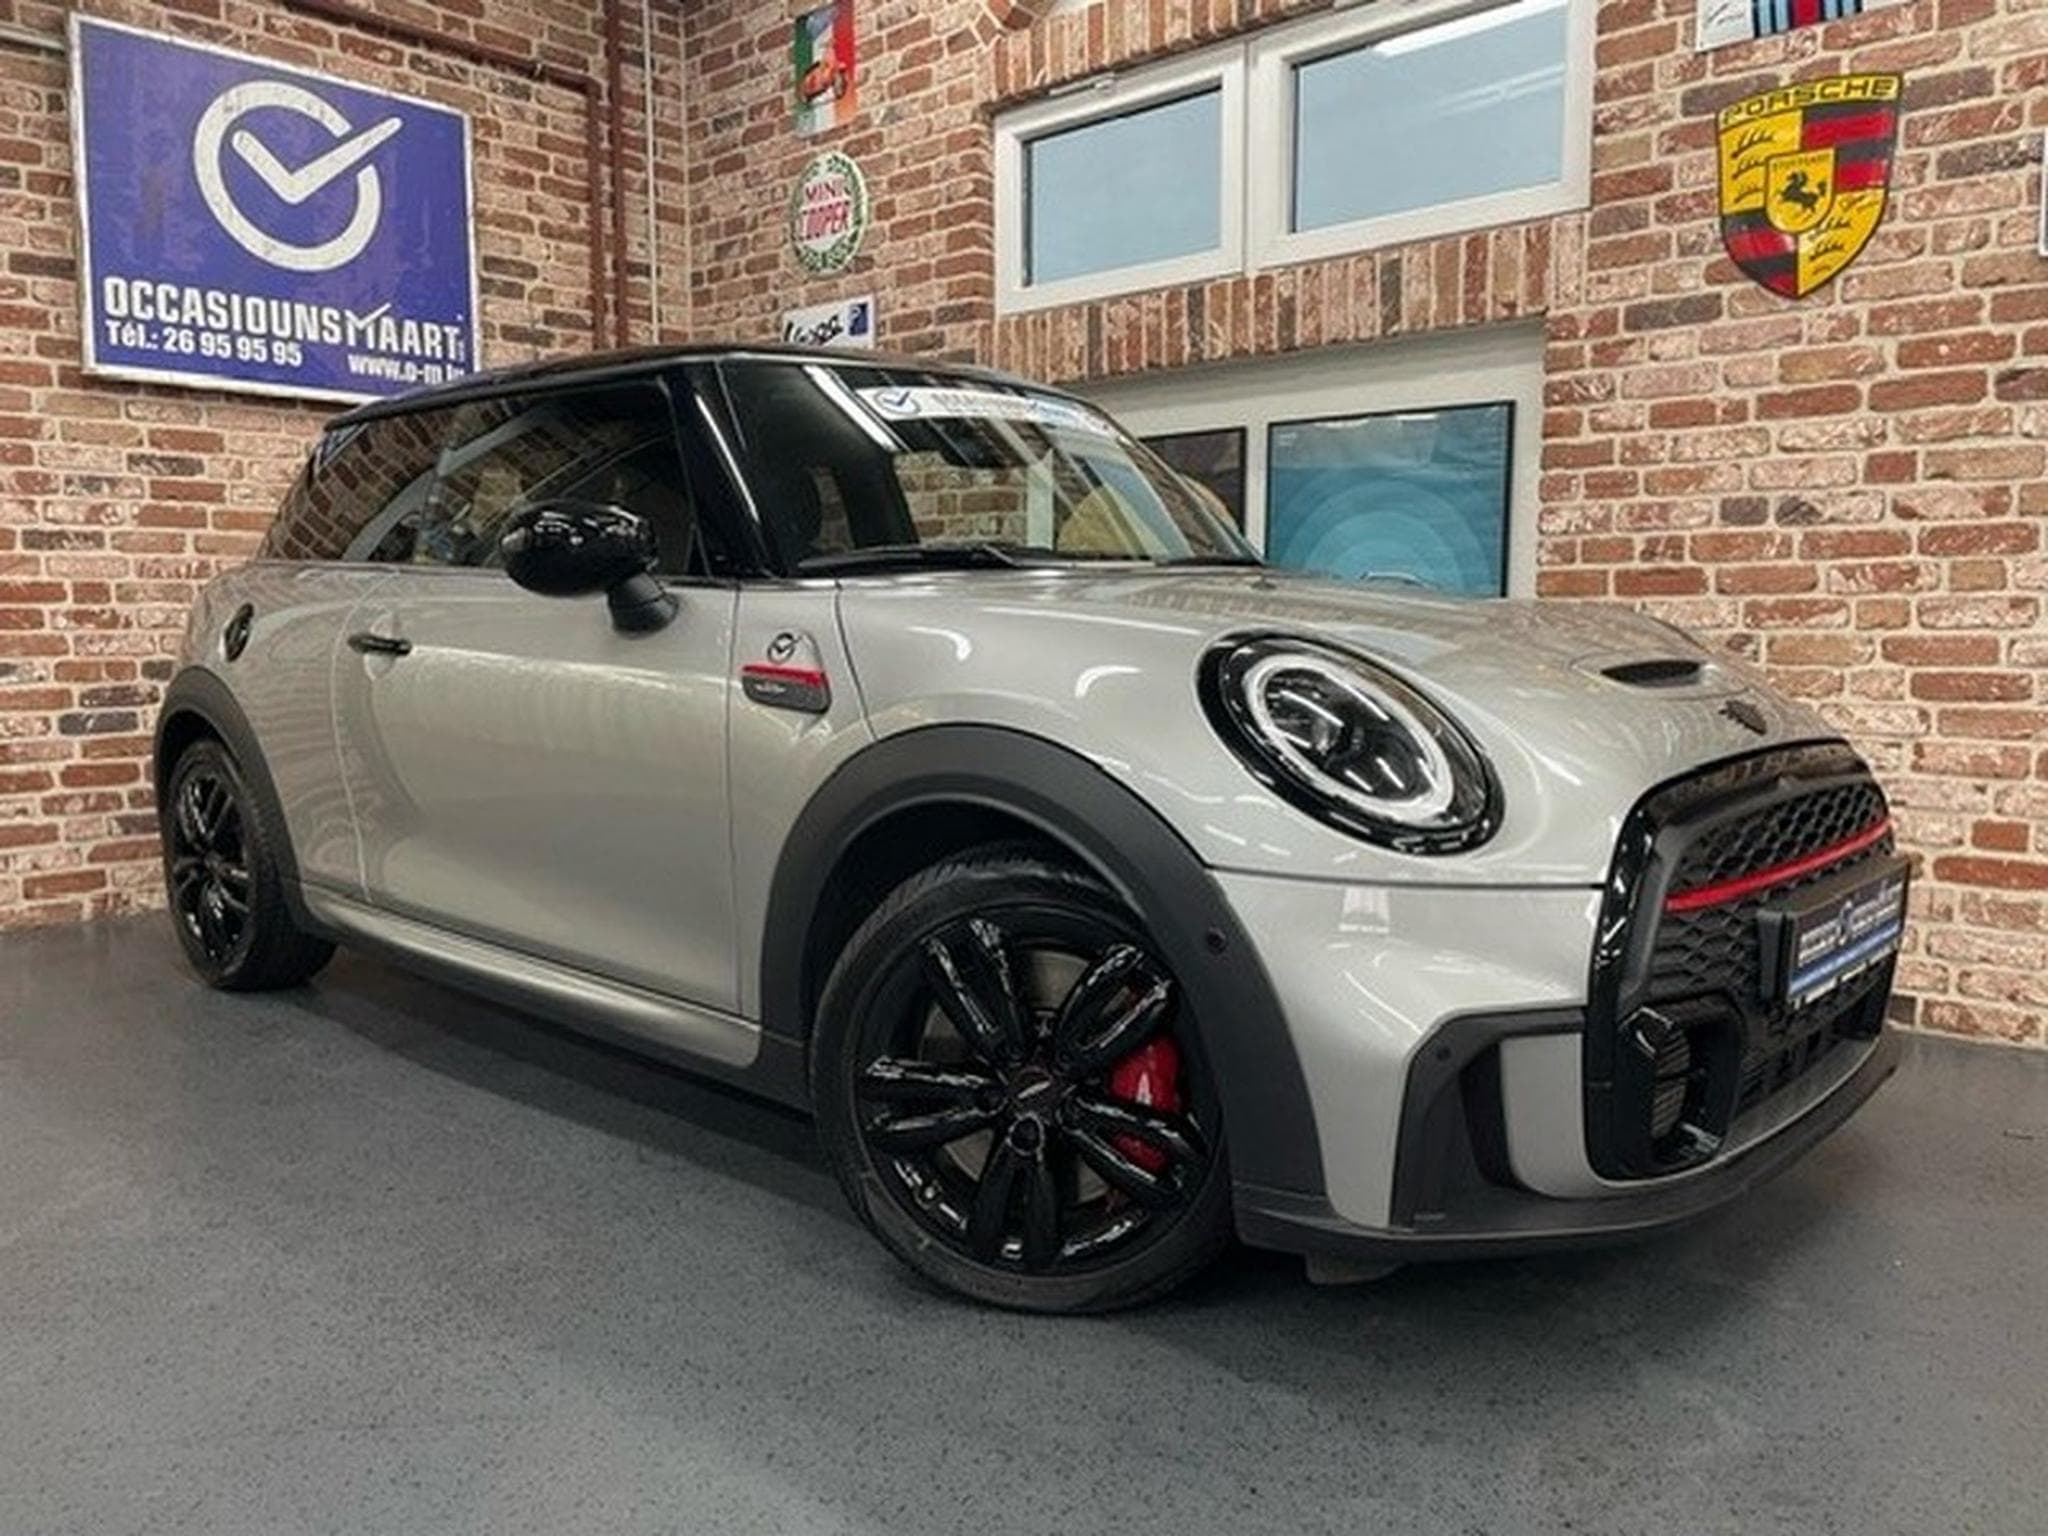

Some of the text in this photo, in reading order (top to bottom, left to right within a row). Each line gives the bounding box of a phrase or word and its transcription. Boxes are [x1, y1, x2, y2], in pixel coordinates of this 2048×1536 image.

[1723, 79, 1893, 125] PORSCHE
[103, 276, 460, 361] OCCASIOUNSMAART
[162, 326, 195, 355] 26
[200, 331, 232, 359] 95
[236, 335, 268, 363] 95
[272, 340, 302, 367] 95
